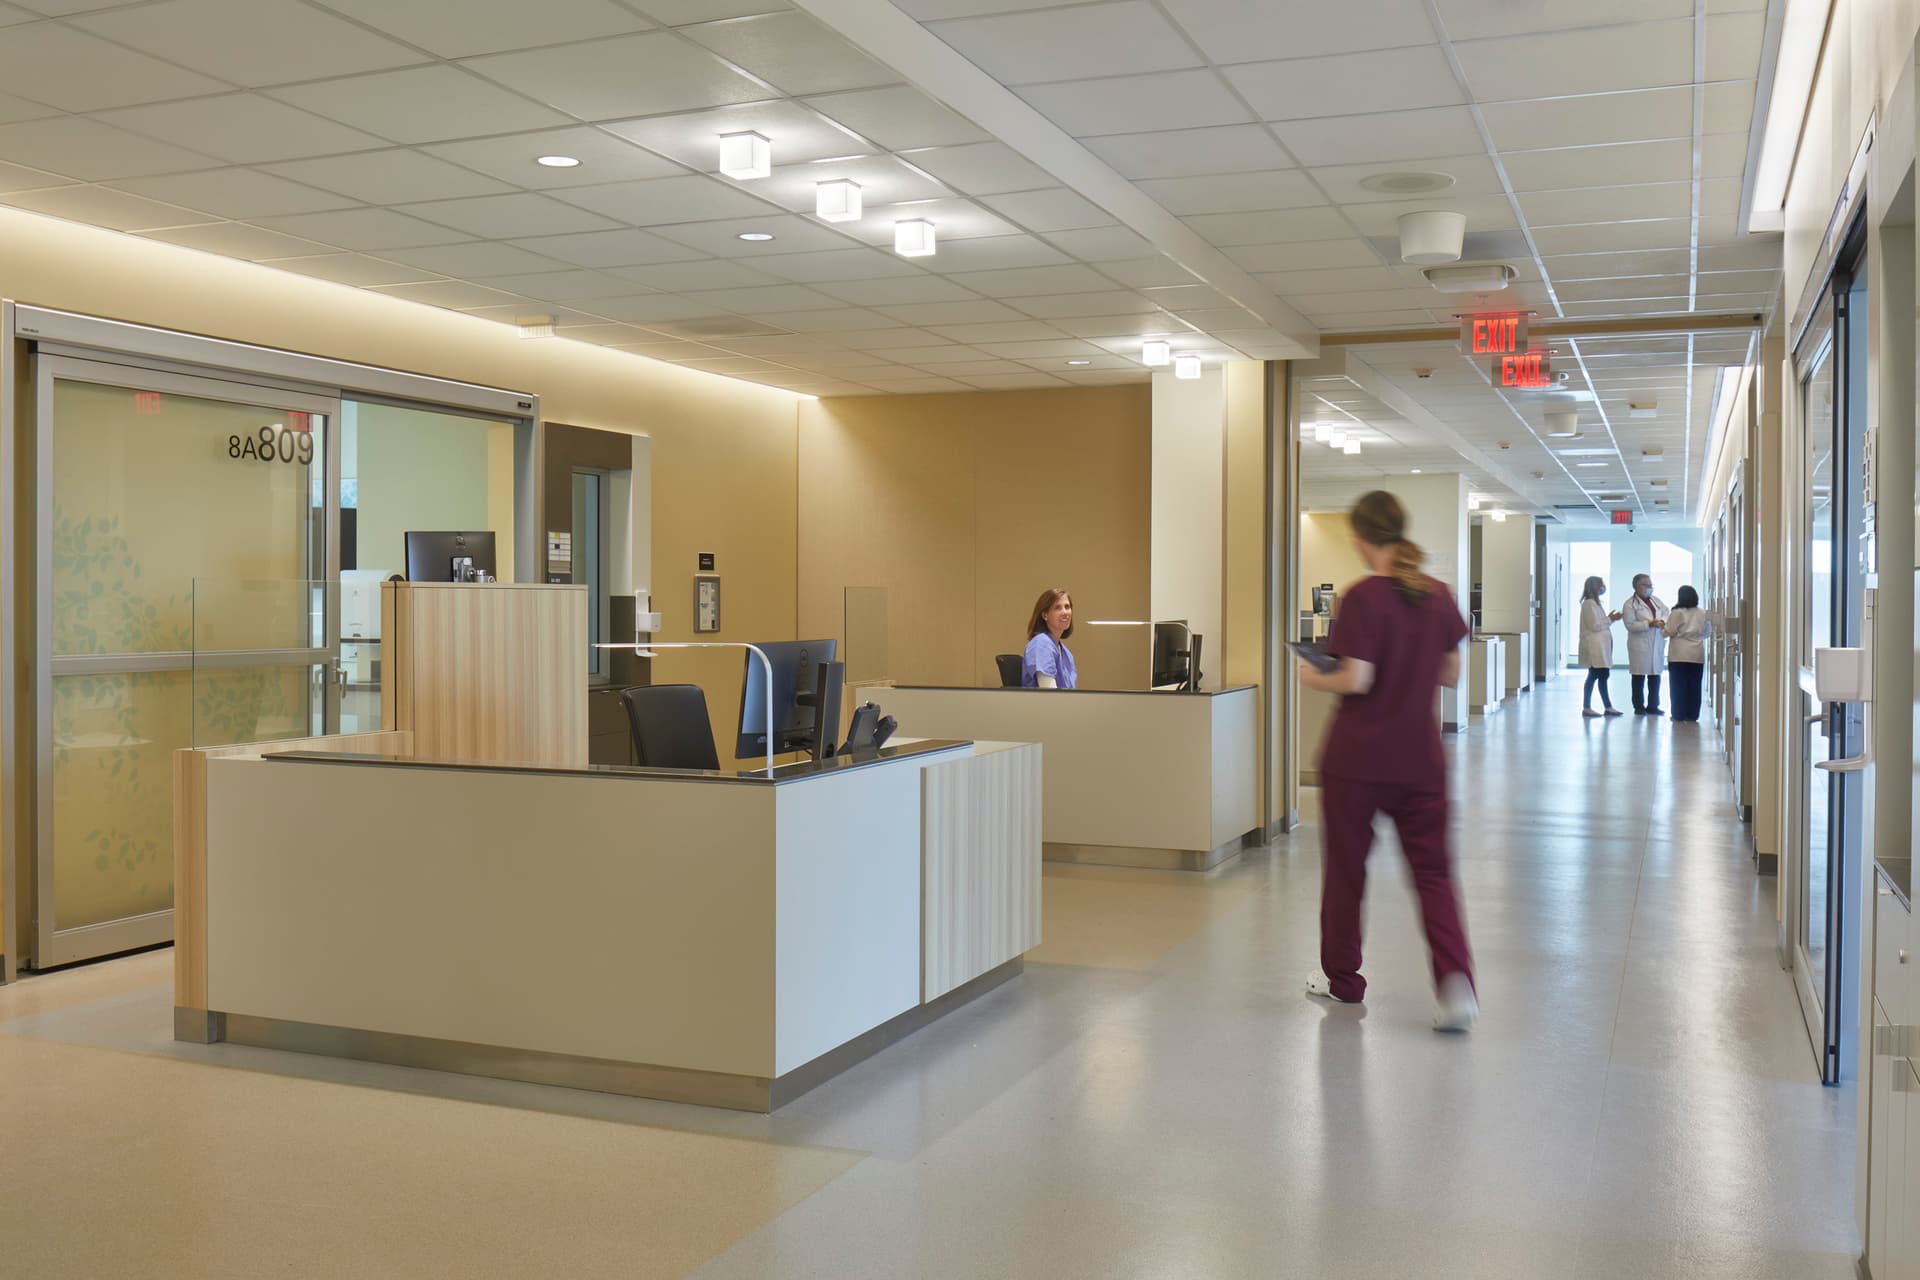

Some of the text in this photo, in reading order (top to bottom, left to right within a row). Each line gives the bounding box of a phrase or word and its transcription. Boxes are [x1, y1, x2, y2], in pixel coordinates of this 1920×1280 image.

[1472, 318, 1519, 354] EXIT
[1501, 354, 1542, 386] EXIT
[228, 426, 314, 465] 8A809
